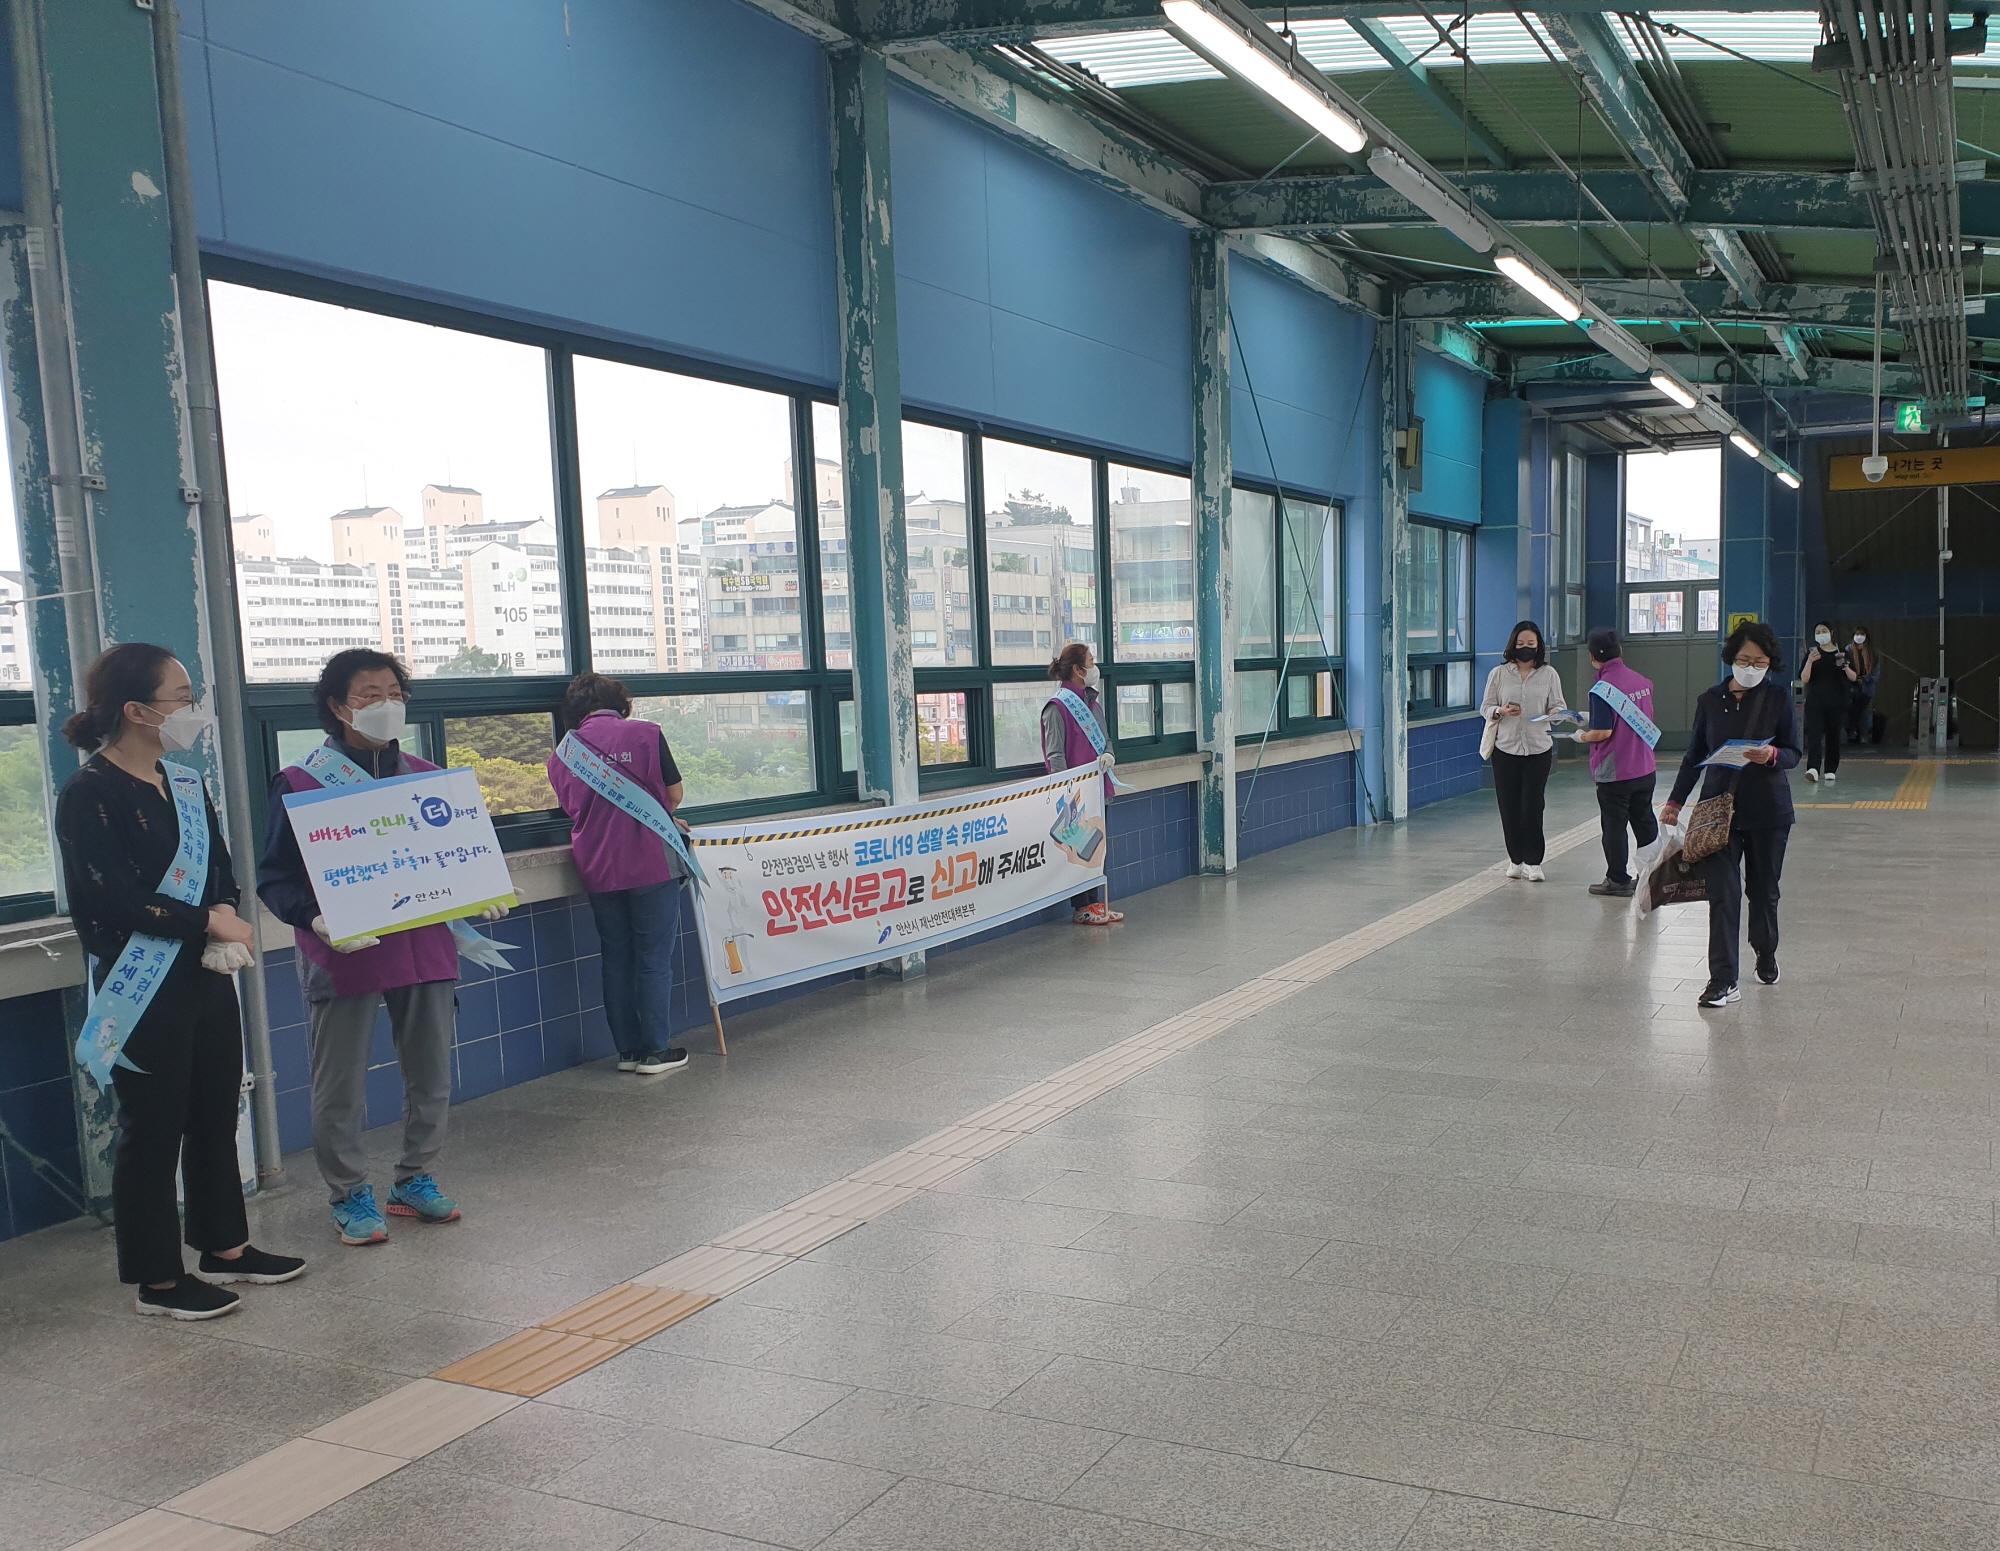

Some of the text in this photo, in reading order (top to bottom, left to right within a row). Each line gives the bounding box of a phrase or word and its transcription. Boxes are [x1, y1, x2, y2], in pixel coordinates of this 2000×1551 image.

[1931, 457, 1943, 470] 곳
[500, 581, 516, 593] LH
[503, 607, 528, 623] 105
[0, 667, 21, 680] 마을
[311, 753, 333, 769] 안산시
[581, 752, 626, 790] 코로나19
[175, 784, 199, 799] 안산시
[573, 760, 608, 792] 안산시민과
[607, 788, 626, 803] 함께
[624, 800, 652, 821] 반드시
[171, 797, 195, 887] 방역수칙 꼭
[190, 804, 205, 867] 마스크착용
[308, 825, 367, 843] 배려에
[369, 813, 421, 836] 인내를
[761, 813, 1009, 878] 안전점검의 날 행사 코로나19 생활 속 위험요소
[322, 845, 492, 887] 평범했던 하루가 돌아옵니다.
[414, 887, 453, 903] 안산시
[761, 840, 1047, 937] 안전신문고로 신고해 주세요!
[895, 902, 977, 937] 안산시 재난안전대책본부
[108, 945, 146, 997] 주세요
[128, 950, 167, 1006] 즉시검사
